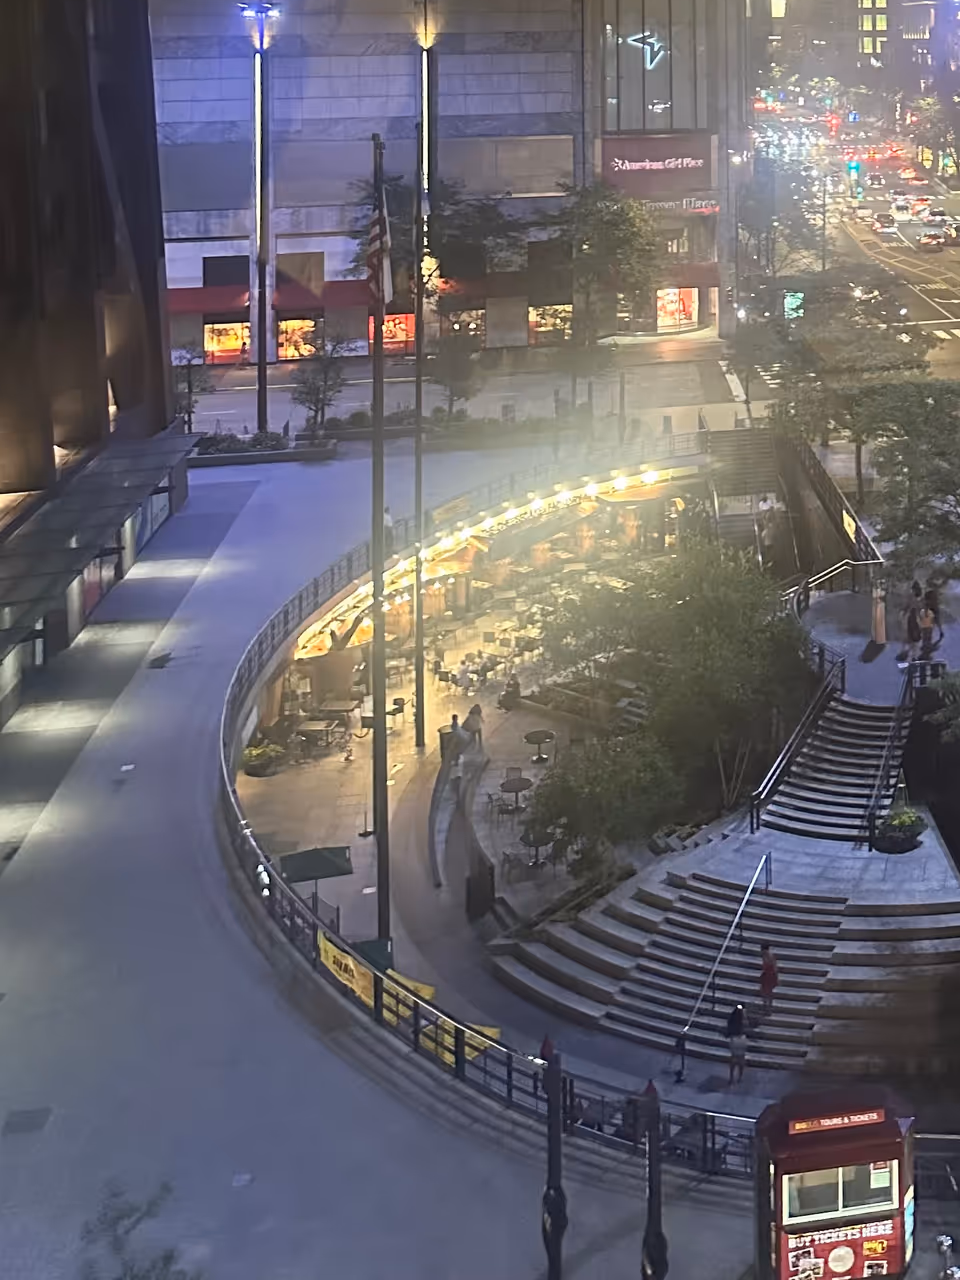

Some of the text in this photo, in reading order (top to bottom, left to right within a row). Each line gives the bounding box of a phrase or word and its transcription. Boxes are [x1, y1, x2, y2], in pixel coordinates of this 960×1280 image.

[788, 1224, 893, 1248] BUY TICKETS HERE
